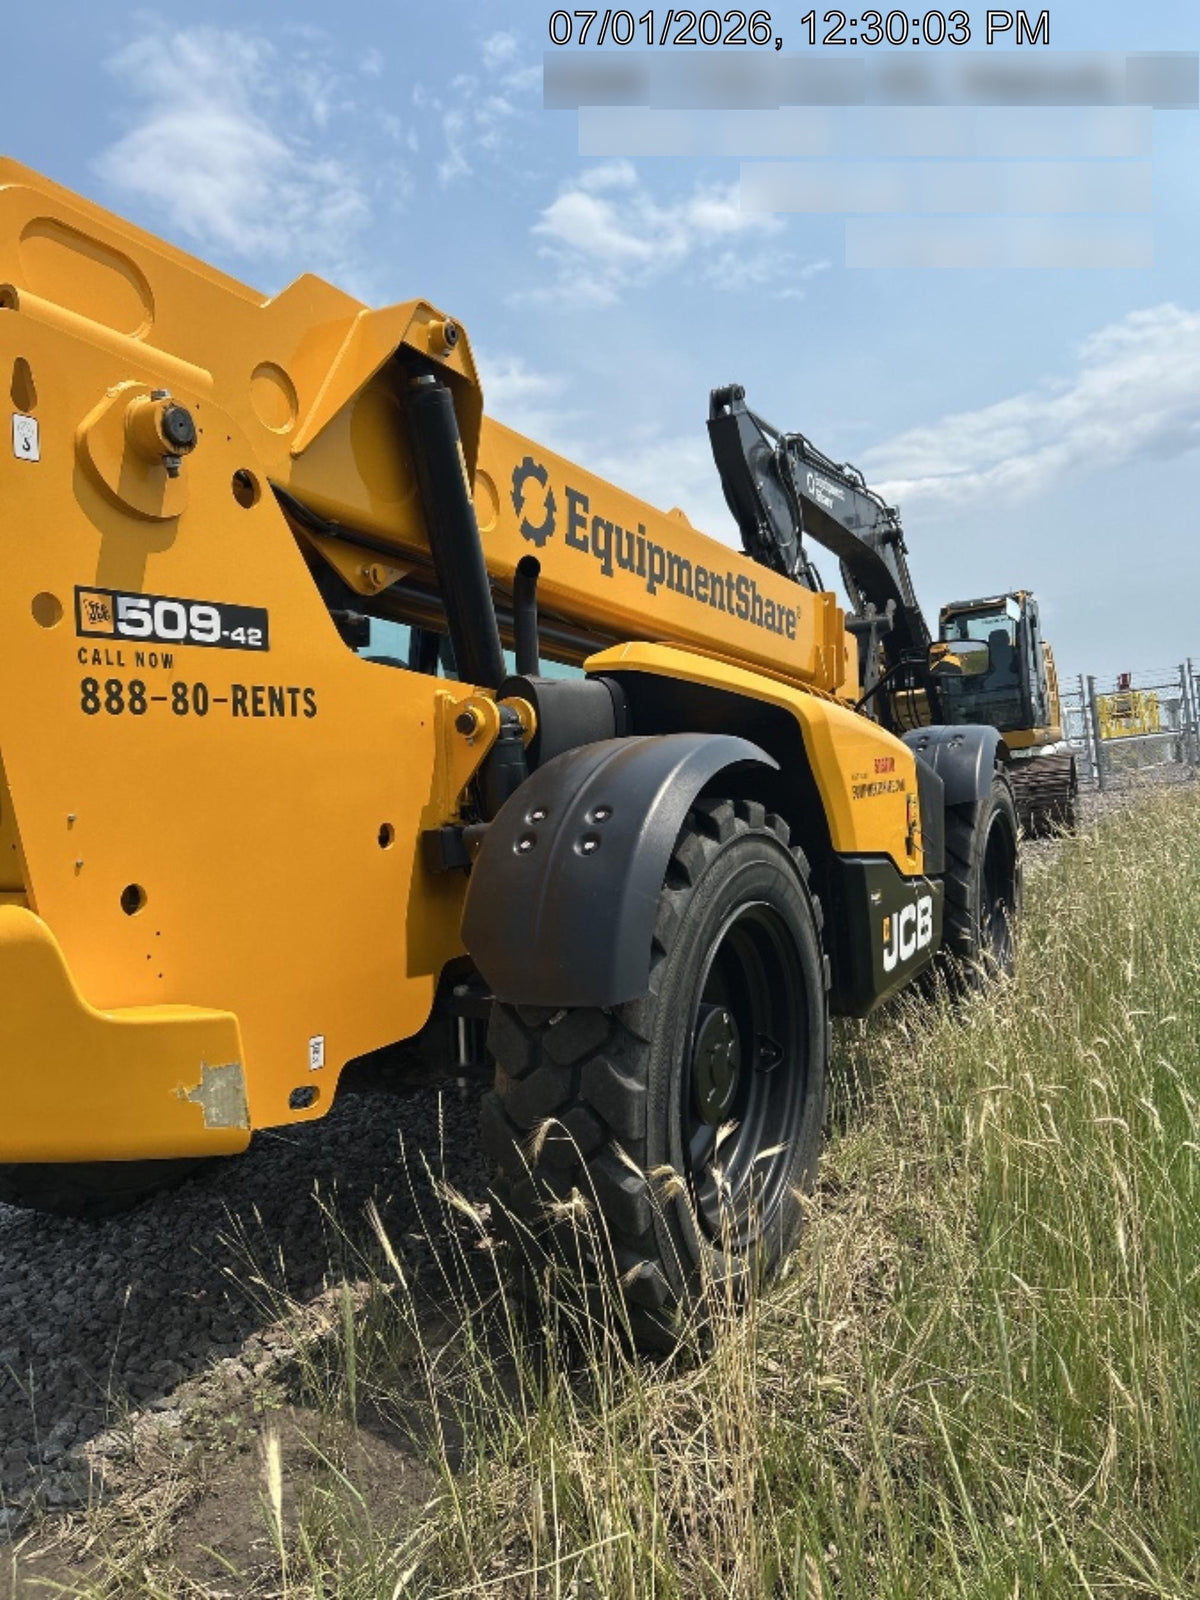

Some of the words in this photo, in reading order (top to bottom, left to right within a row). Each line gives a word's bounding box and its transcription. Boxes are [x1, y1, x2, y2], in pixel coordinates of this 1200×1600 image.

[116, 595, 263, 647] 509-42
[77, 646, 126, 668] CALL
[135, 651, 175, 670] NOW
[80, 676, 318, 718] 888-80-RENTS
[882, 895, 933, 972] JCB
